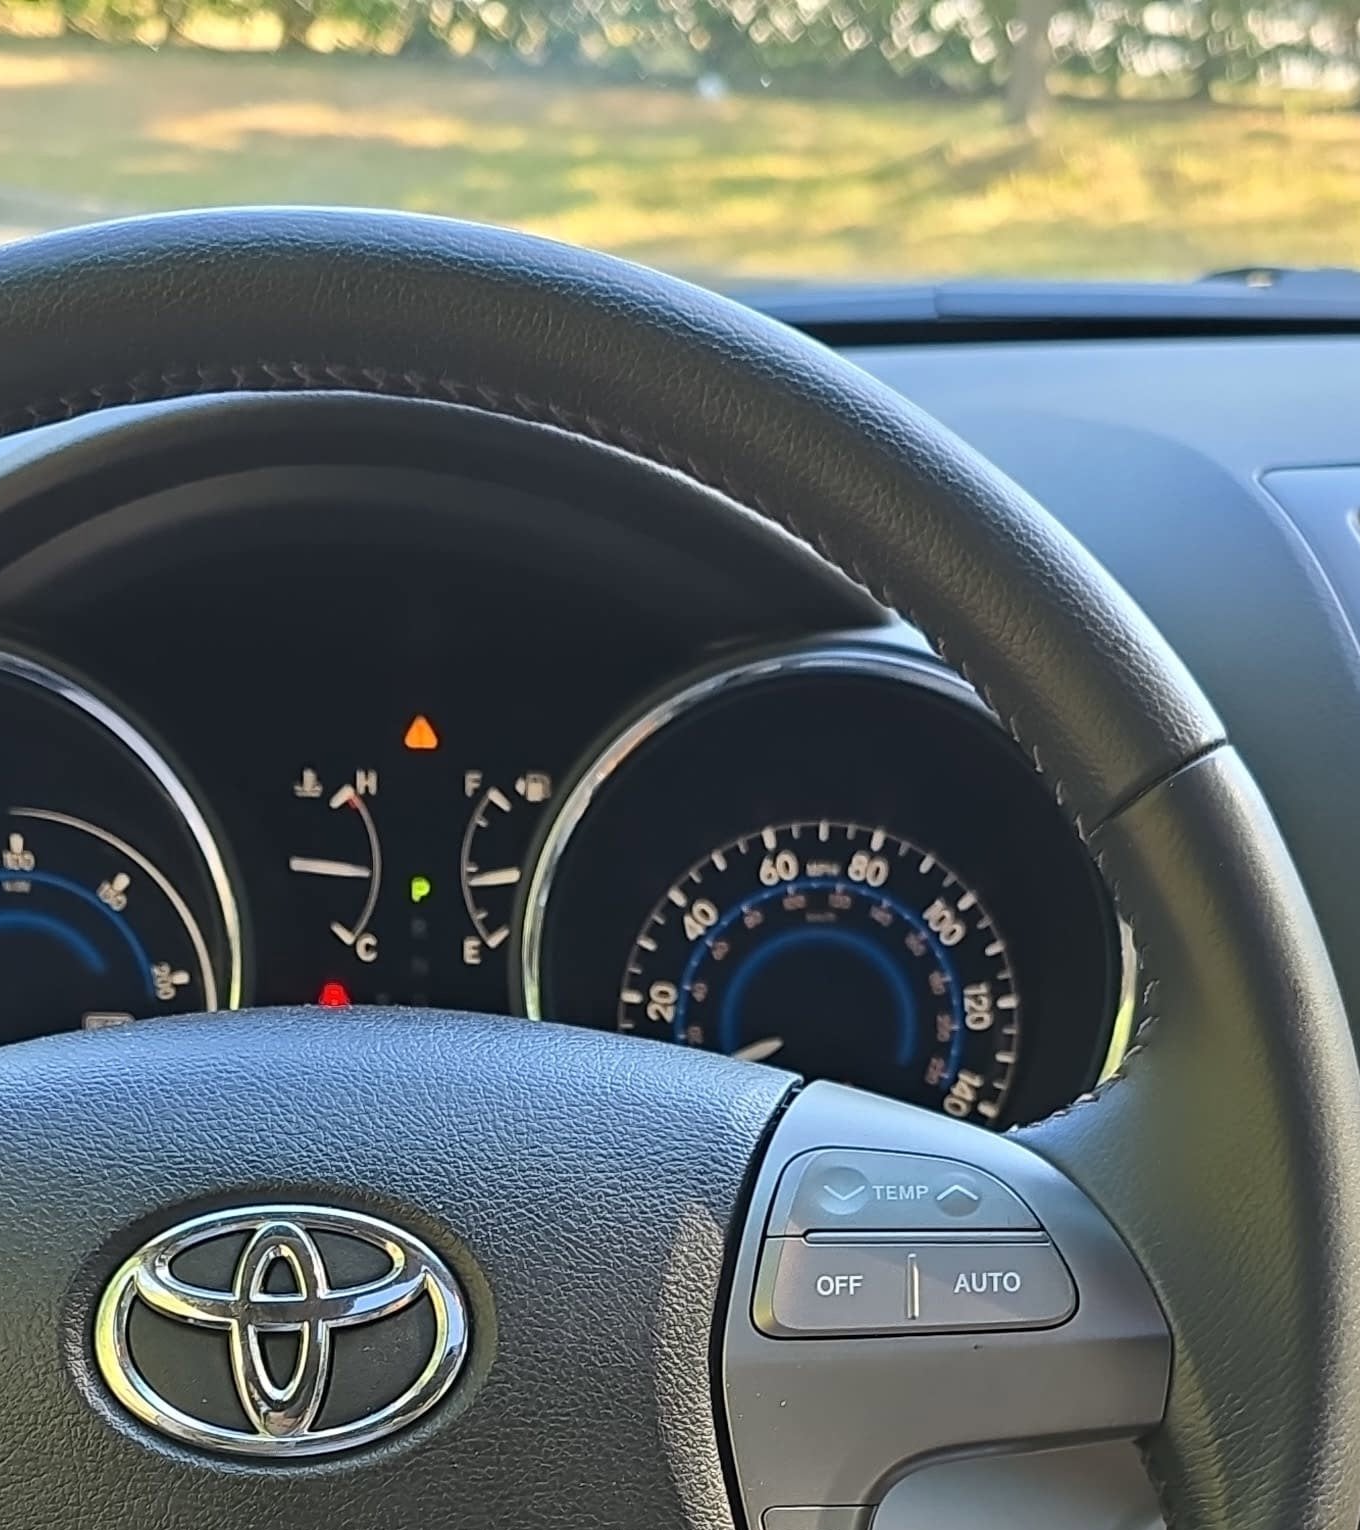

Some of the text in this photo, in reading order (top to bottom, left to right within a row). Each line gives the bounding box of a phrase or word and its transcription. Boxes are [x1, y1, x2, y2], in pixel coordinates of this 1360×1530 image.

[355, 769, 378, 796] H
[464, 769, 483, 798] F
[759, 849, 799, 886] 60
[847, 850, 889, 888] 80
[410, 875, 432, 903] P
[683, 898, 718, 941] 40
[923, 898, 967, 949] 100
[355, 933, 378, 963] C
[462, 936, 482, 965] E
[647, 981, 678, 1024] 20
[963, 982, 993, 1031] 120
[943, 1070, 984, 1117] 140
[872, 1185, 929, 1200] TEMP
[816, 1275, 863, 1296] OFF
[953, 1272, 1021, 1294] AUTO
